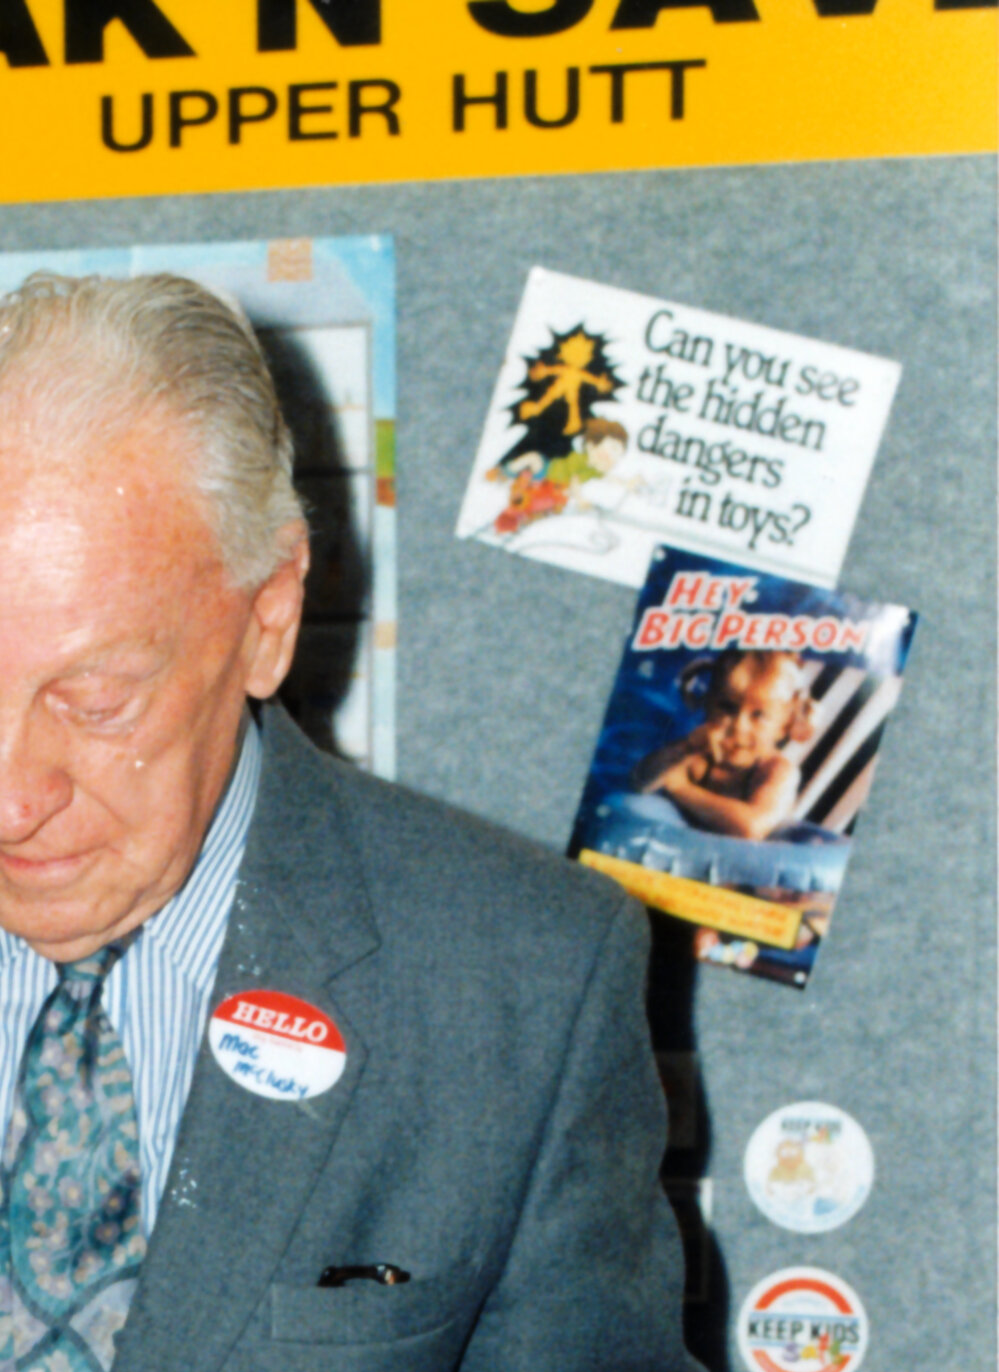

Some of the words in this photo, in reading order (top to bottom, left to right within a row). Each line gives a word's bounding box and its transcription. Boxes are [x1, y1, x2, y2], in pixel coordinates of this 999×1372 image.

[99, 79, 403, 153] UPPER
[452, 58, 707, 133] HUTT
[644, 309, 714, 368] Can
[724, 341, 790, 388] you
[797, 365, 861, 407] see
[636, 363, 695, 413] the
[700, 379, 828, 452] hidden
[636, 415, 786, 489] dangers
[675, 476, 711, 523] in
[718, 497, 812, 551] toys?
[633, 609, 712, 648] BIG
[713, 611, 866, 650] PERSON
[231, 1001, 329, 1043] HELLO
[748, 1319, 804, 1340] KEEP
[810, 1320, 860, 1345] KIDS
